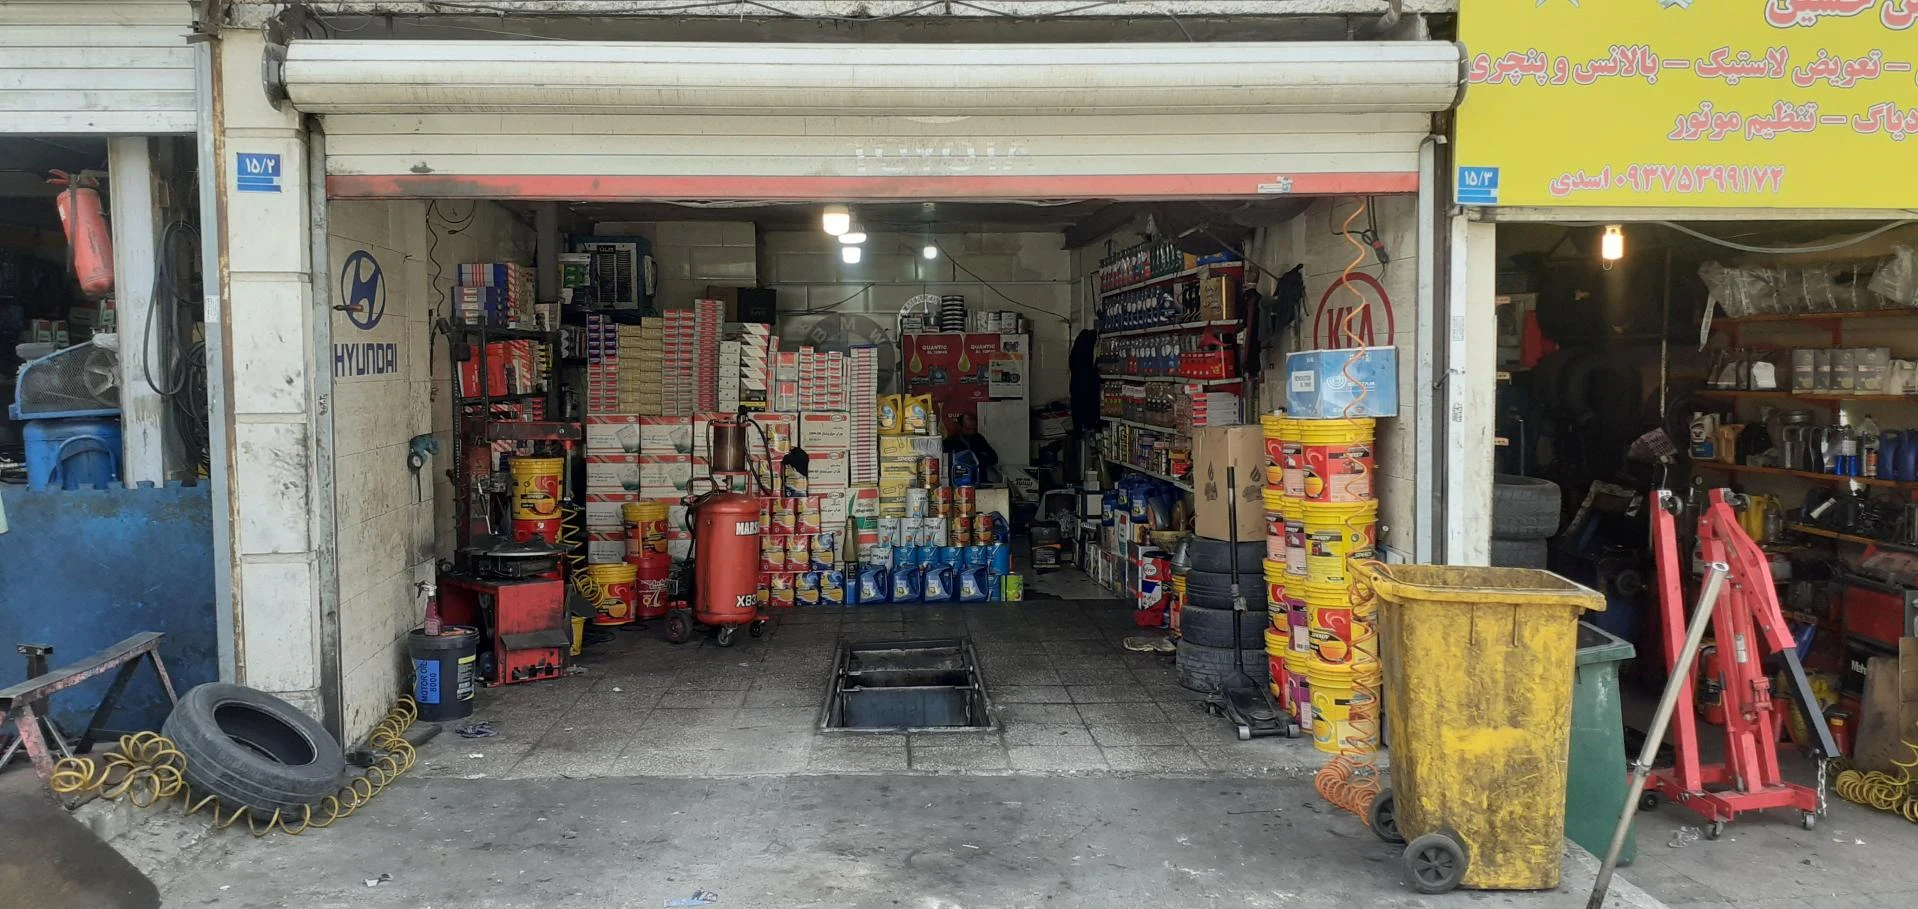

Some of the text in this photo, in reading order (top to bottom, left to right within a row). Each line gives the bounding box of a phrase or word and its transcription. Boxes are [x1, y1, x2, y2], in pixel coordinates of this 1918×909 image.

[1468, 48, 1547, 85] پنچری
[1550, 56, 1569, 85] و
[1573, 45, 1659, 85] بالانس
[1695, 46, 1788, 86] لاستیک
[1791, 48, 1883, 88] تعویض
[1668, 101, 1742, 141] موتور
[1745, 100, 1818, 141] تنظیم
[1549, 164, 1785, 197] ۰۹۳۷۵۳۹۹۱۷۲ اسدی
[1327, 303, 1376, 350] KIA
[334, 342, 399, 377] HYUNDAI
[735, 520, 760, 536] MARS
